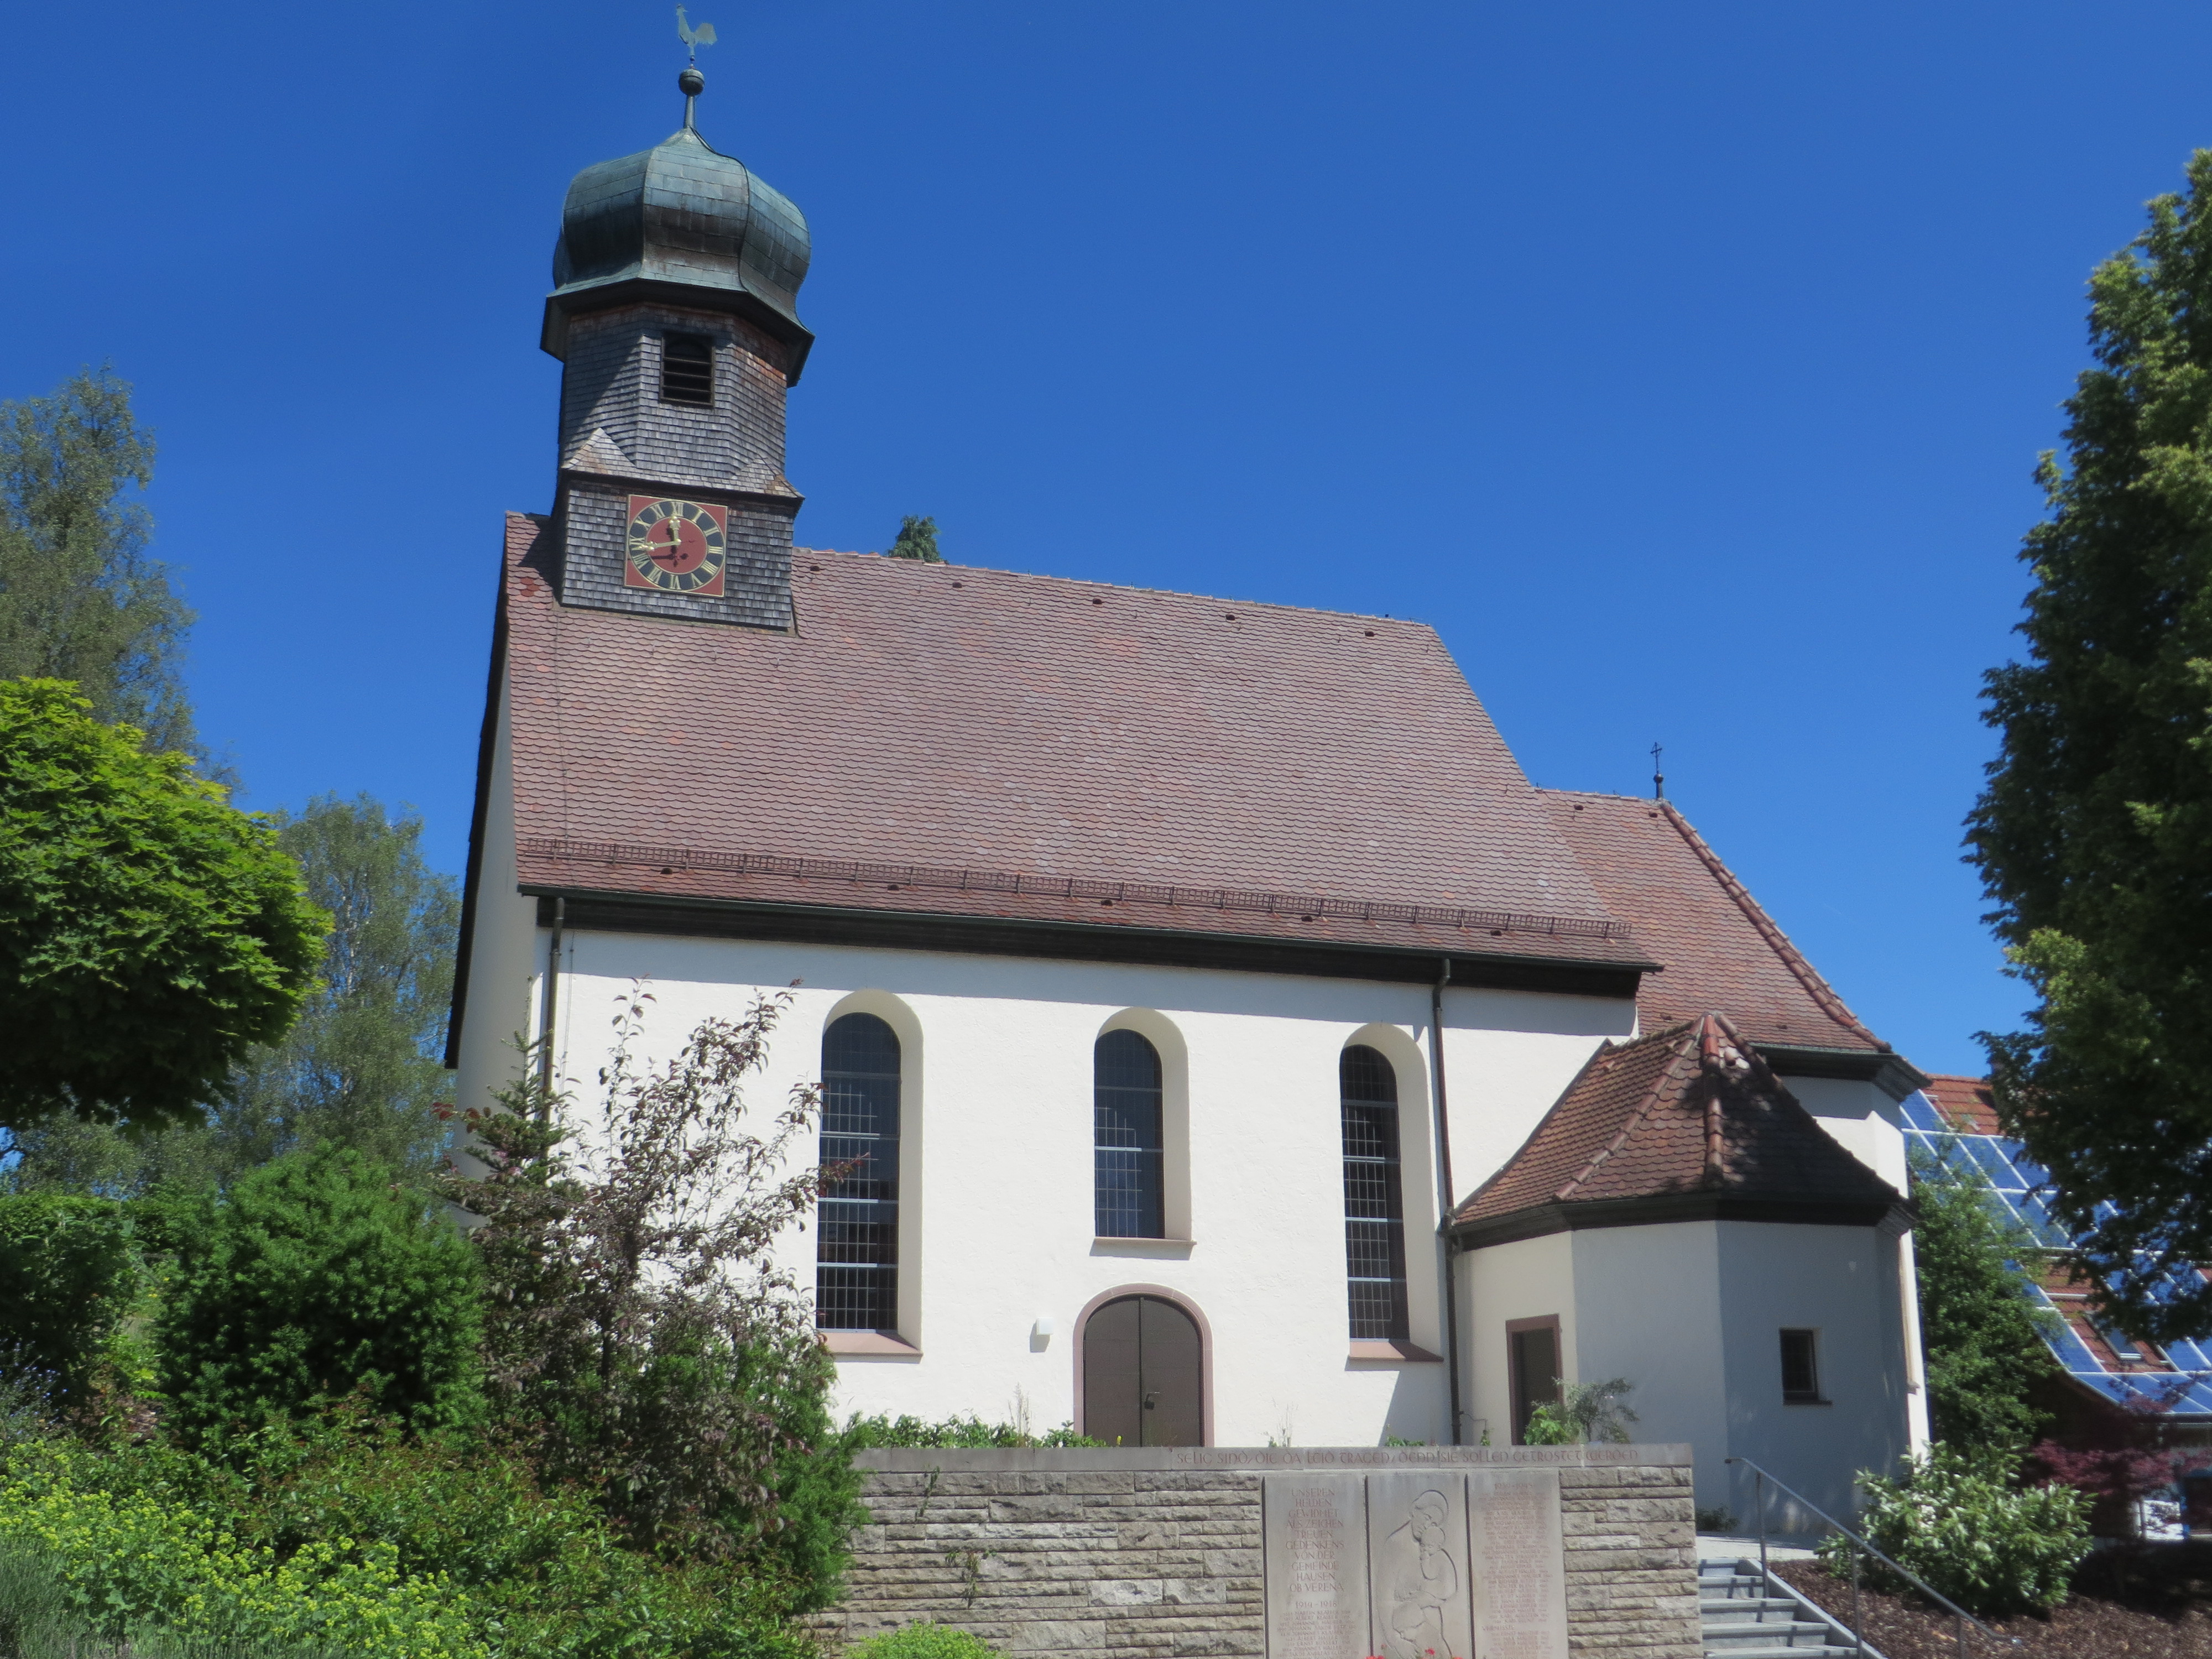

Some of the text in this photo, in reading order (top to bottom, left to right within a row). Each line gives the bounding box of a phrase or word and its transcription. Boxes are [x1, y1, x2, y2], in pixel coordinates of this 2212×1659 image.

[650, 504, 666, 520] XI
[671, 502, 684, 517] XII
[692, 509, 704, 523] I
[634, 516, 652, 530] X
[703, 526, 720, 536] II
[708, 546, 723, 554] III
[670, 575, 681, 589] VI
[691, 573, 703, 588] V
[1255, 1450, 1277, 1464] DIE
[1283, 1450, 1301, 1464] DA
[1307, 1451, 1334, 1464] LEID
[1399, 1451, 1434, 1464] DENN
[1441, 1451, 1458, 1463] SIE
[1463, 1451, 1509, 1463] SOLLEN
[1585, 1448, 1638, 1461] WERDEN
[1291, 1488, 1335, 1497] UNSEREN
[1296, 1498, 1332, 1507] HELDEN
[1288, 1509, 1339, 1518] GEWIDMET
[1286, 1520, 1344, 1528] ALS ZEICHEN
[1296, 1530, 1333, 1538] TREUEN
[1285, 1540, 1344, 1550] GEDENKENS
[1295, 1551, 1335, 1559] VON DER
[1292, 1561, 1339, 1571] GEMEINDE
[1297, 1572, 1335, 1581] HAUSEN
[1290, 1582, 1344, 1592] OB VERENA
